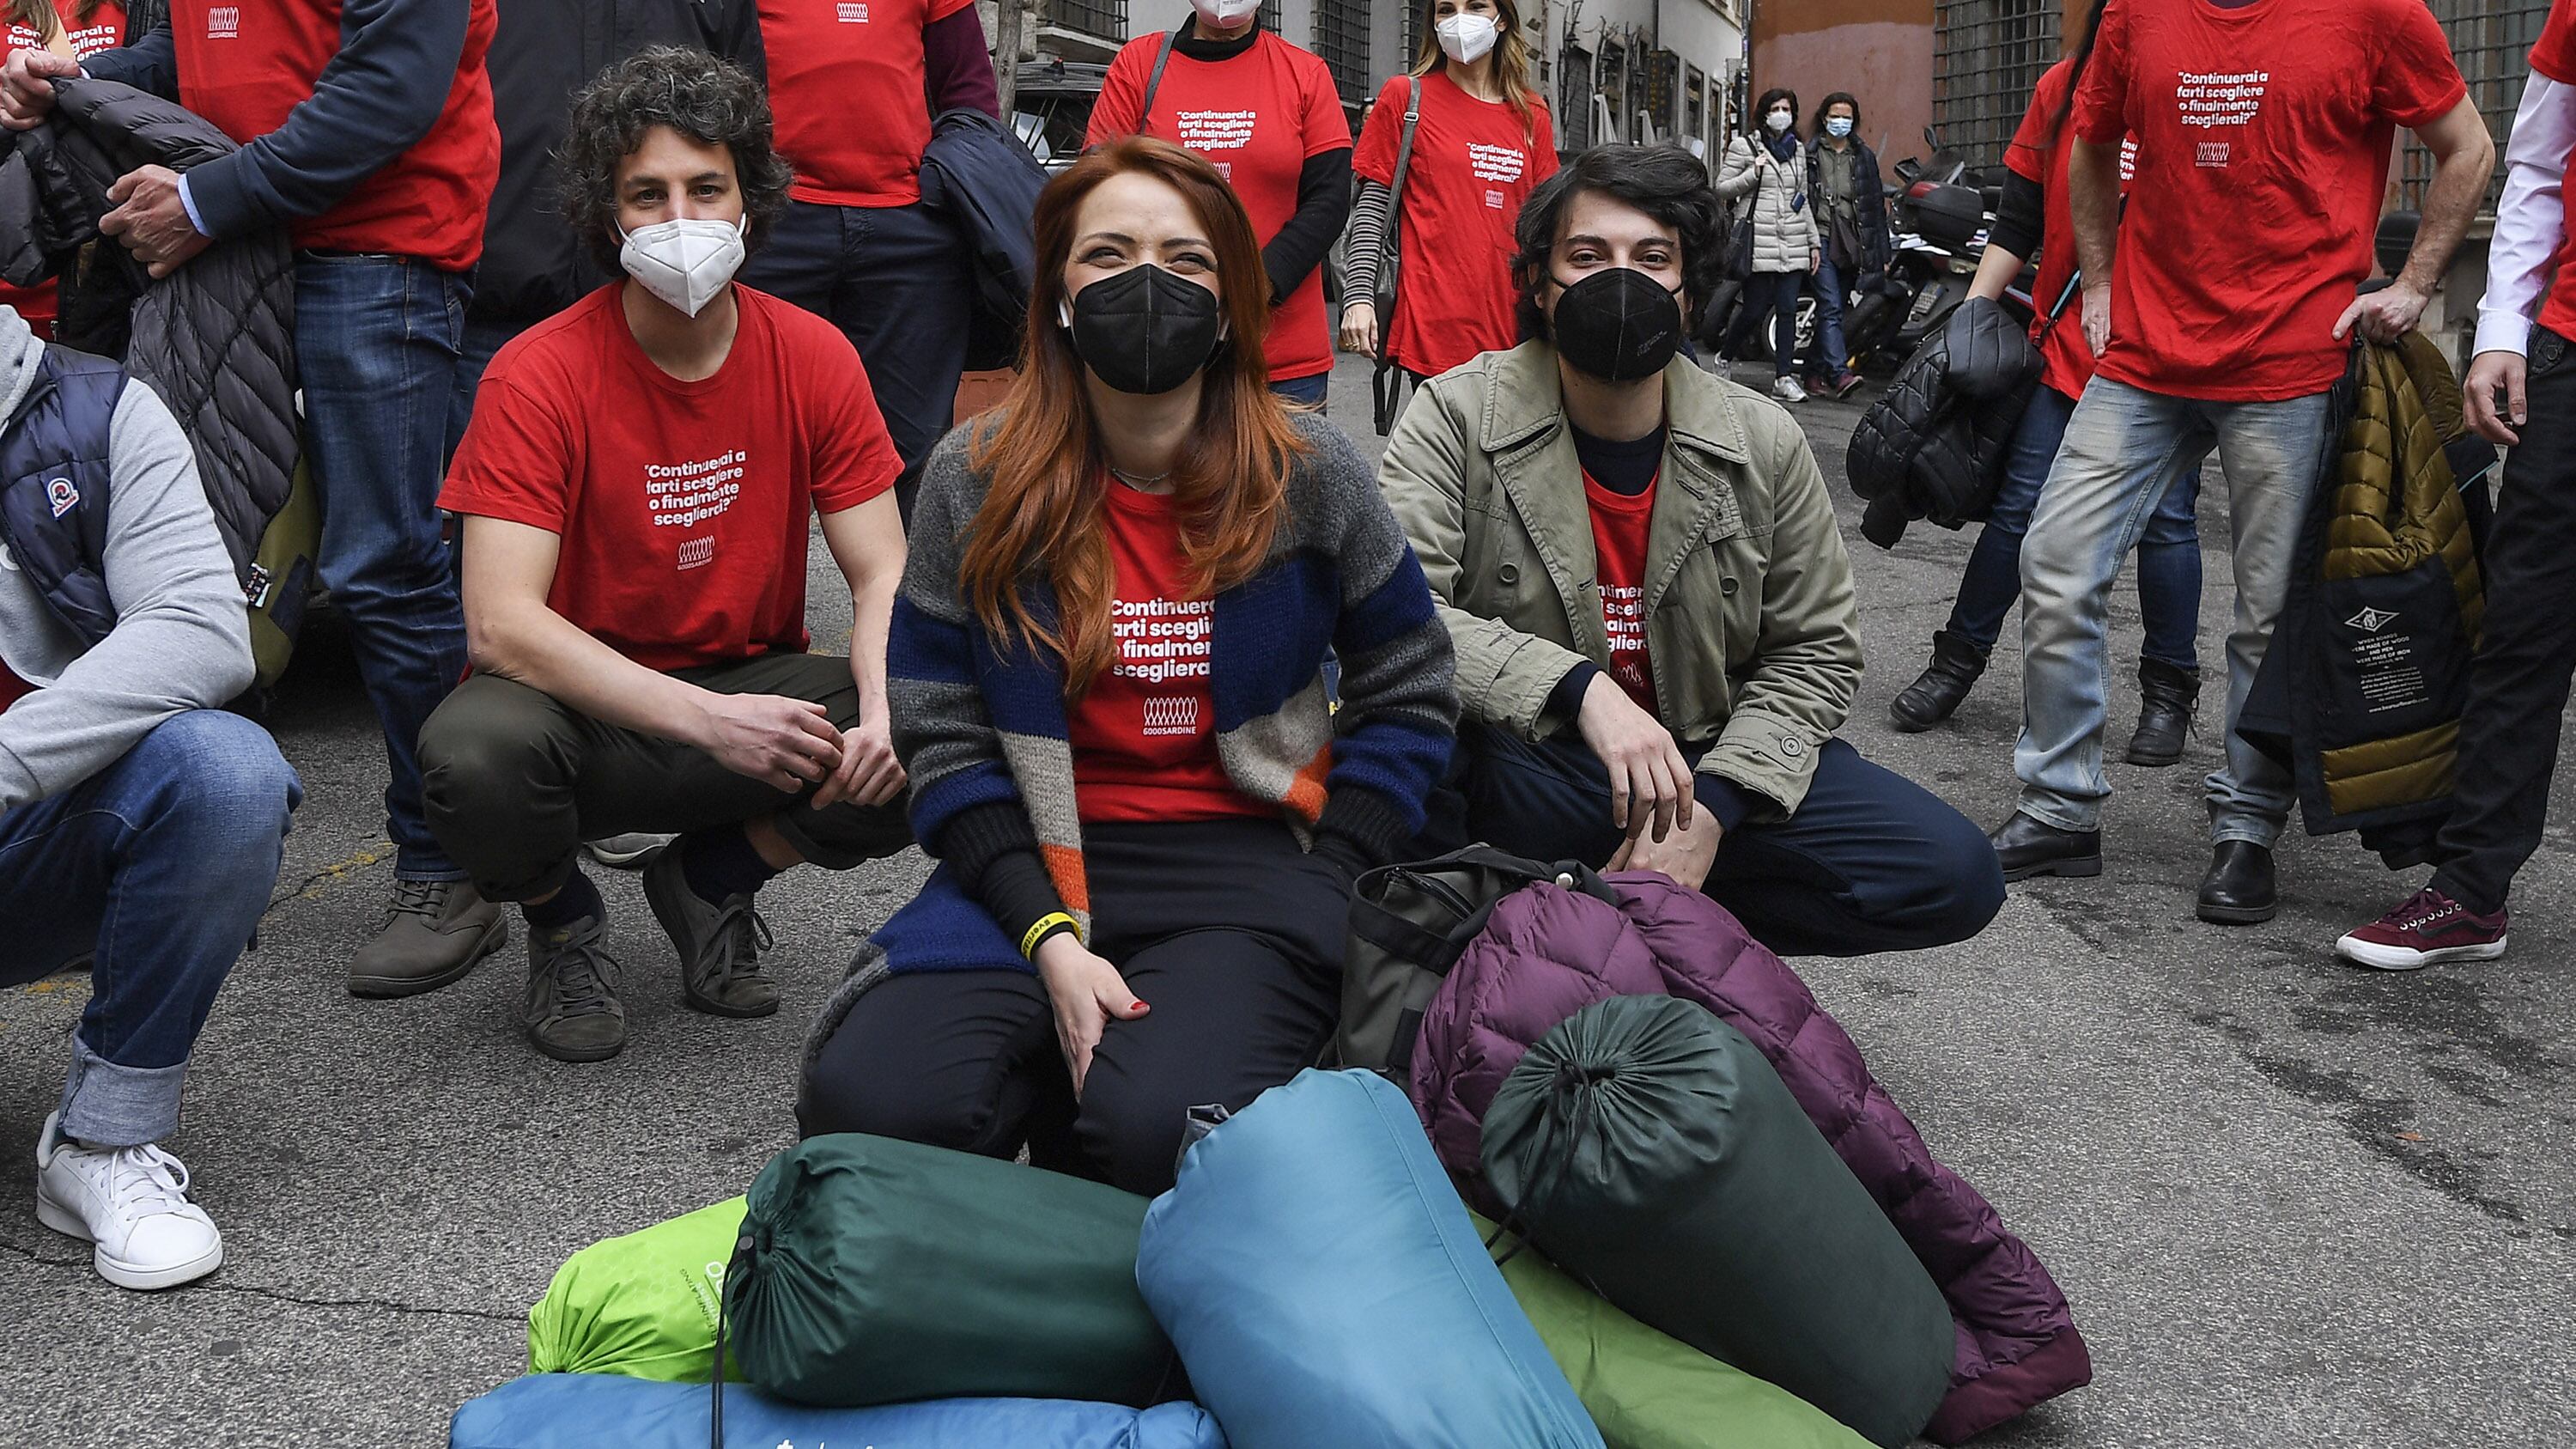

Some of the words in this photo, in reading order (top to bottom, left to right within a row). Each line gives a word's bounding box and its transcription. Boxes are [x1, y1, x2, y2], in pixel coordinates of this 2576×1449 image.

[104, 26, 116, 34] a
[2178, 70, 2258, 84] "Continuerai
[2259, 72, 2269, 82] a
[2177, 85, 2205, 98] farti
[2206, 85, 2264, 100] scegliere
[2178, 101, 2187, 110] o
[2189, 100, 2259, 112] finalmente
[1176, 110, 1247, 119] "Continuerai
[2181, 111, 2257, 129] sceglierai?"
[1177, 119, 1202, 129] farti
[1203, 119, 1255, 131] scegliere
[1180, 130, 1188, 138] o
[1189, 128, 1252, 138] finalmente
[1183, 137, 1251, 151] sceglierai?"
[1466, 142, 1517, 158] "Continuerai
[1469, 151, 1487, 161] farti
[1487, 155, 1524, 167] scegliere
[1478, 160, 1522, 175] finalmente
[1473, 170, 1520, 183] sceglierai?"
[644, 449, 733, 478] "Continueai
[735, 450, 746, 462] a
[646, 478, 680, 495] farti
[682, 466, 744, 491] sceglere
[648, 498, 659, 510] o
[653, 496, 738, 527] sceglierai?"
[1112, 618, 1146, 637] arti
[1149, 616, 1214, 641] scegli
[2391, 636, 2410, 644] WOOD
[1113, 659, 1211, 683] scegliera
[1143, 726, 1196, 736] 6000SARDINE
[679, 1268, 718, 1342] ELF-INFLATING
